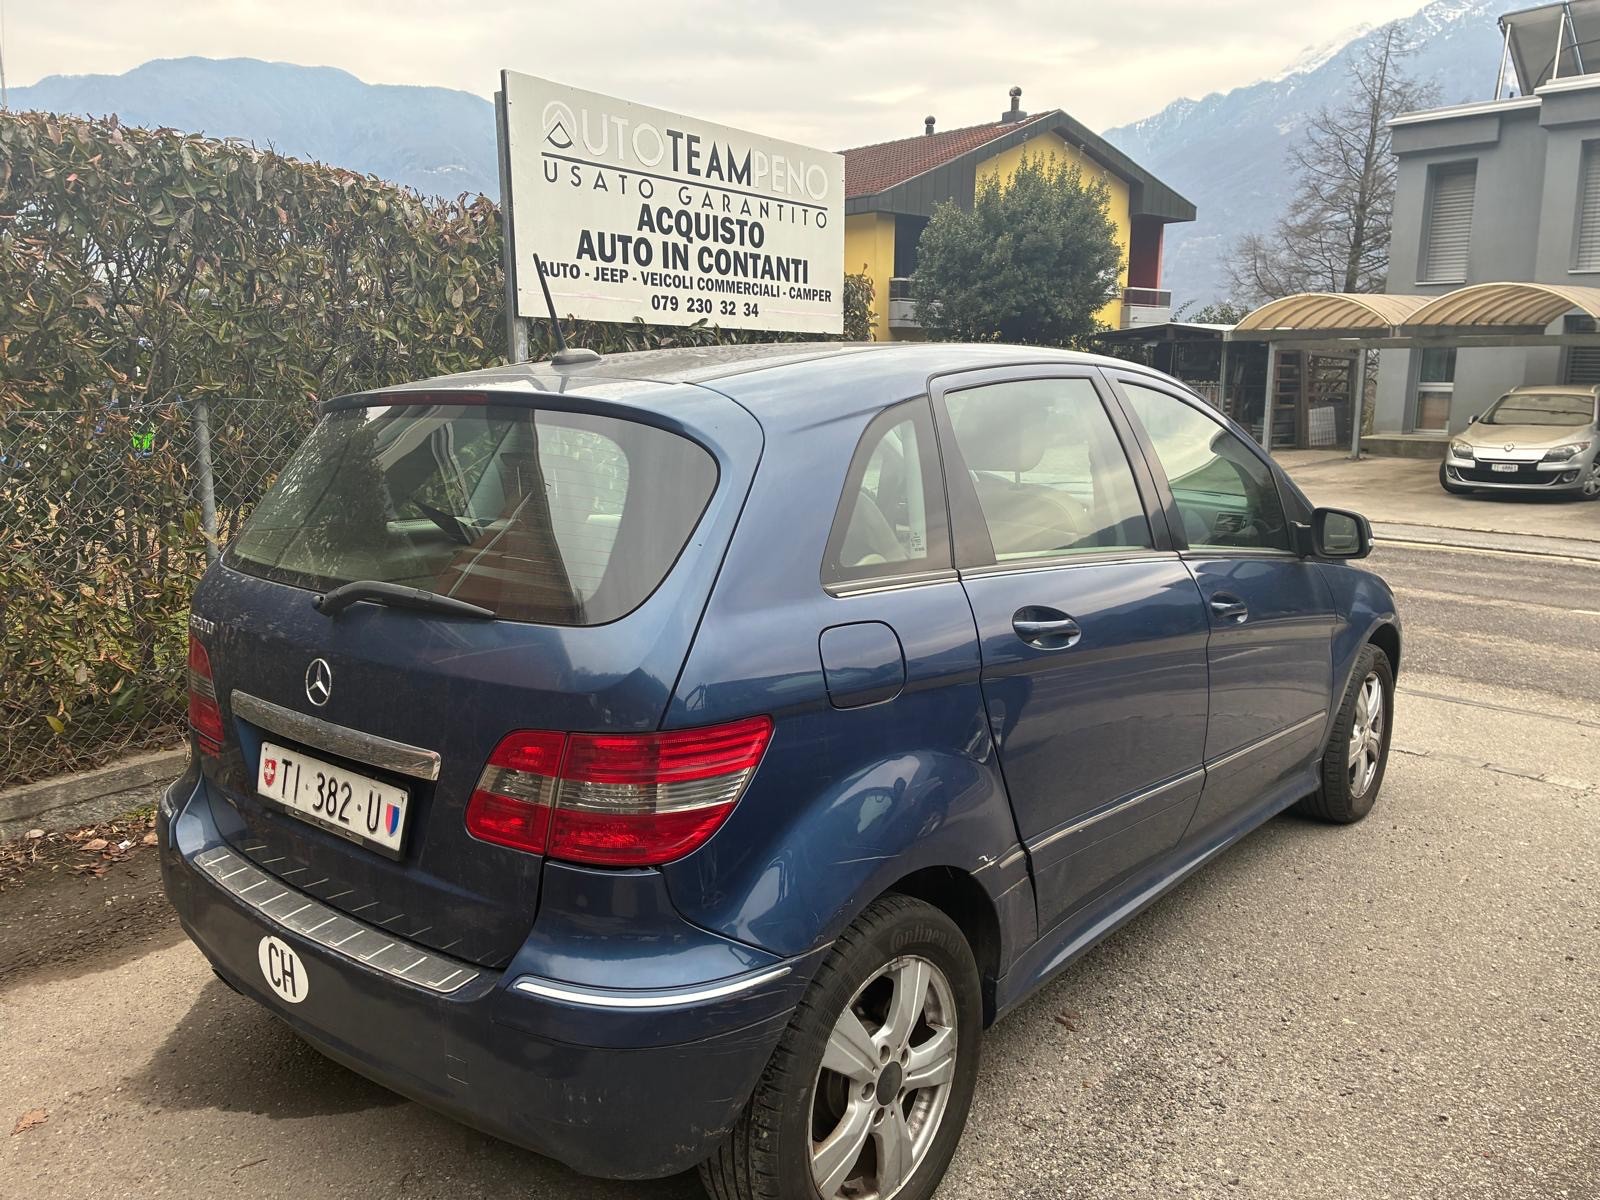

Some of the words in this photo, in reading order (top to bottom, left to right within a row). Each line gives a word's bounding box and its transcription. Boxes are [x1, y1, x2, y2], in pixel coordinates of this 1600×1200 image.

[543, 159, 655, 199] USATO
[678, 186, 828, 229] GARANTITO
[637, 203, 765, 249] ACQUISTO
[540, 260, 581, 279] AUTO
[593, 266, 629, 284] JEEP
[640, 271, 694, 290] VEICOLI
[697, 277, 780, 298] COMMERCIALI
[789, 286, 832, 302] CAMPER
[576, 229, 654, 267] AUTO
[662, 240, 689, 271] IN
[697, 245, 808, 284] CONTANTI
[651, 294, 679, 312] 079
[686, 297, 713, 314] 230
[720, 300, 736, 316] 32
[743, 302, 759, 318] 34
[268, 942, 297, 998] CH
